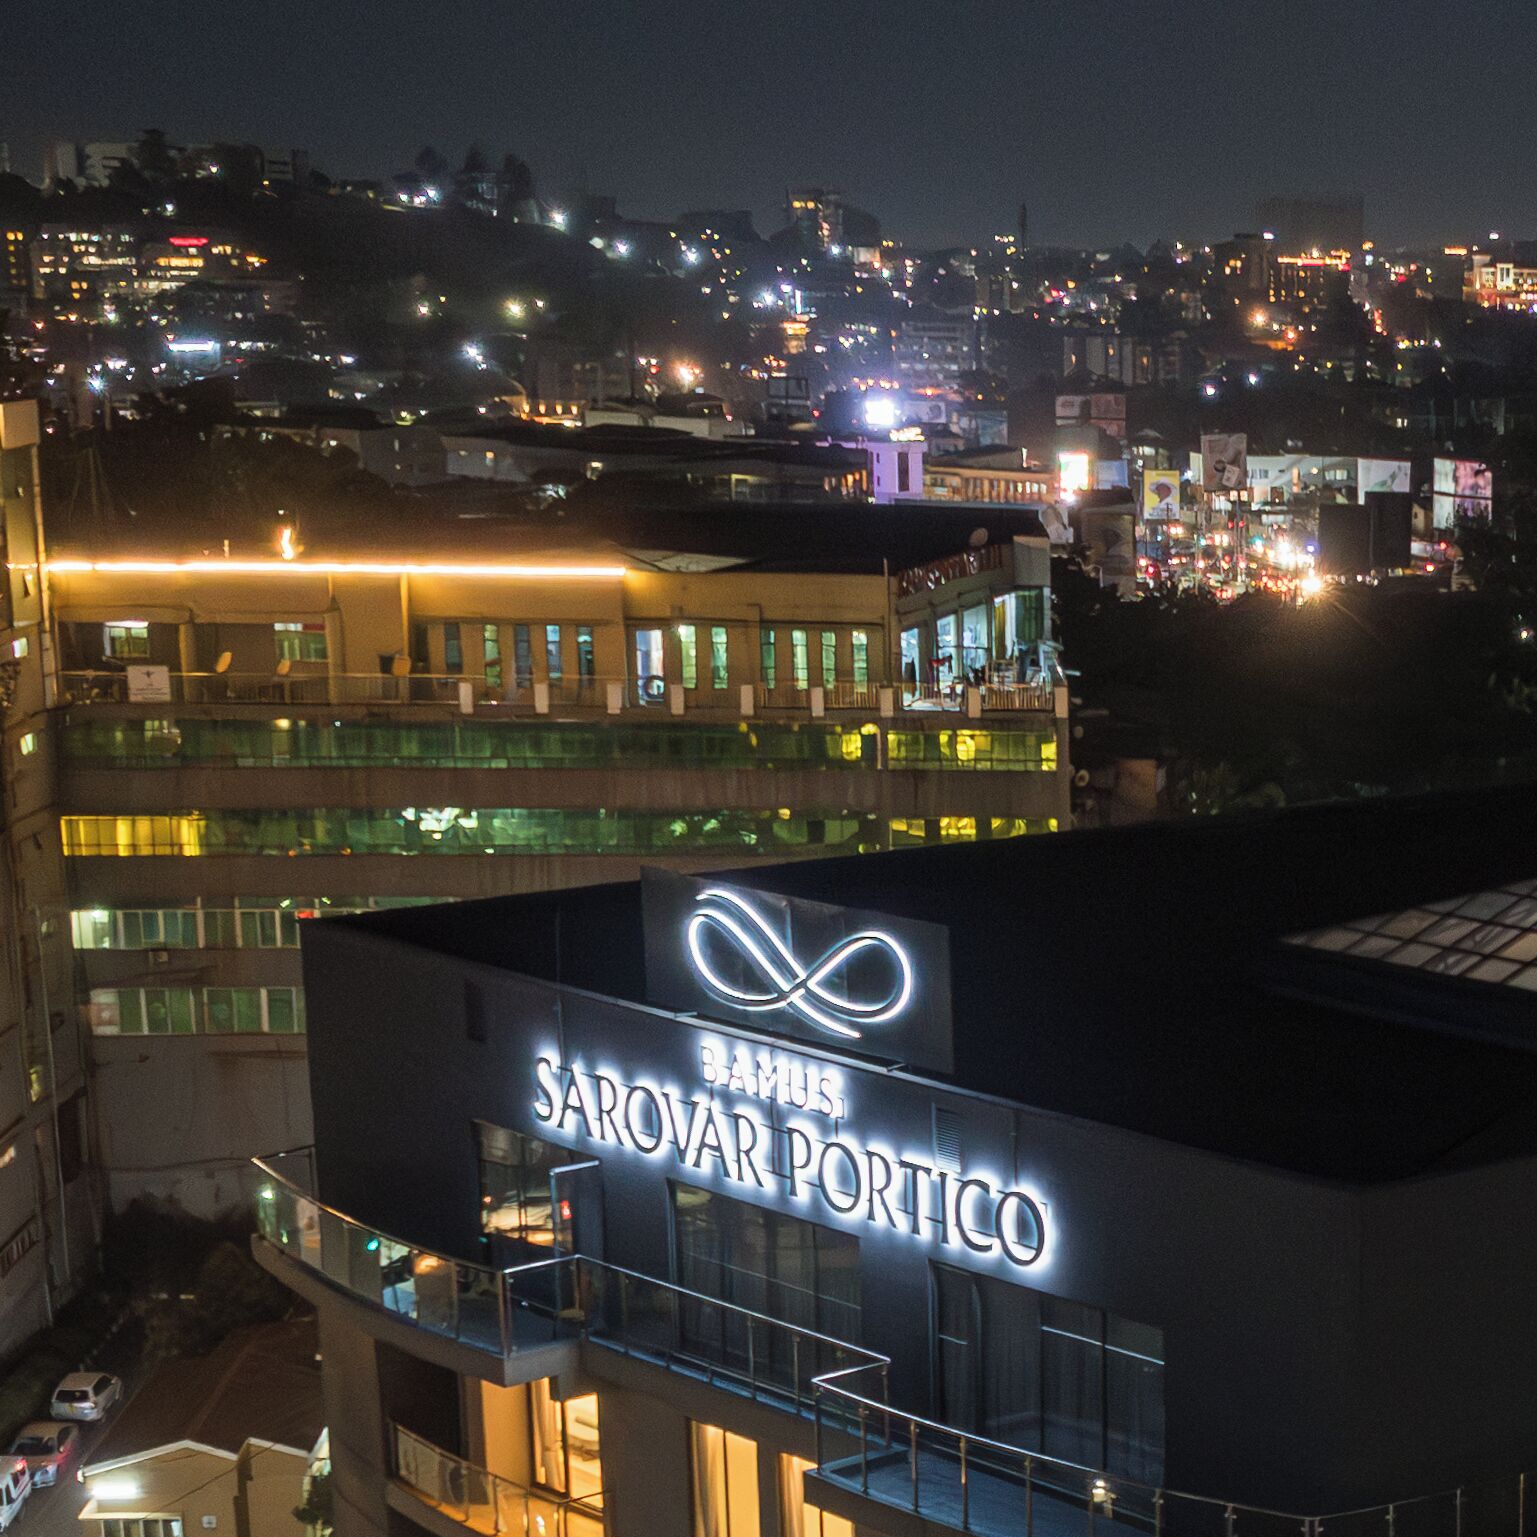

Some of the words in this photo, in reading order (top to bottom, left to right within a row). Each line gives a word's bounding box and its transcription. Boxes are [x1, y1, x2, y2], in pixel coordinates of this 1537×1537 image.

[699, 1043, 838, 1117] BAMUS
[534, 1056, 765, 1189] SAROVAR
[786, 1125, 1047, 1266] PORTICO
